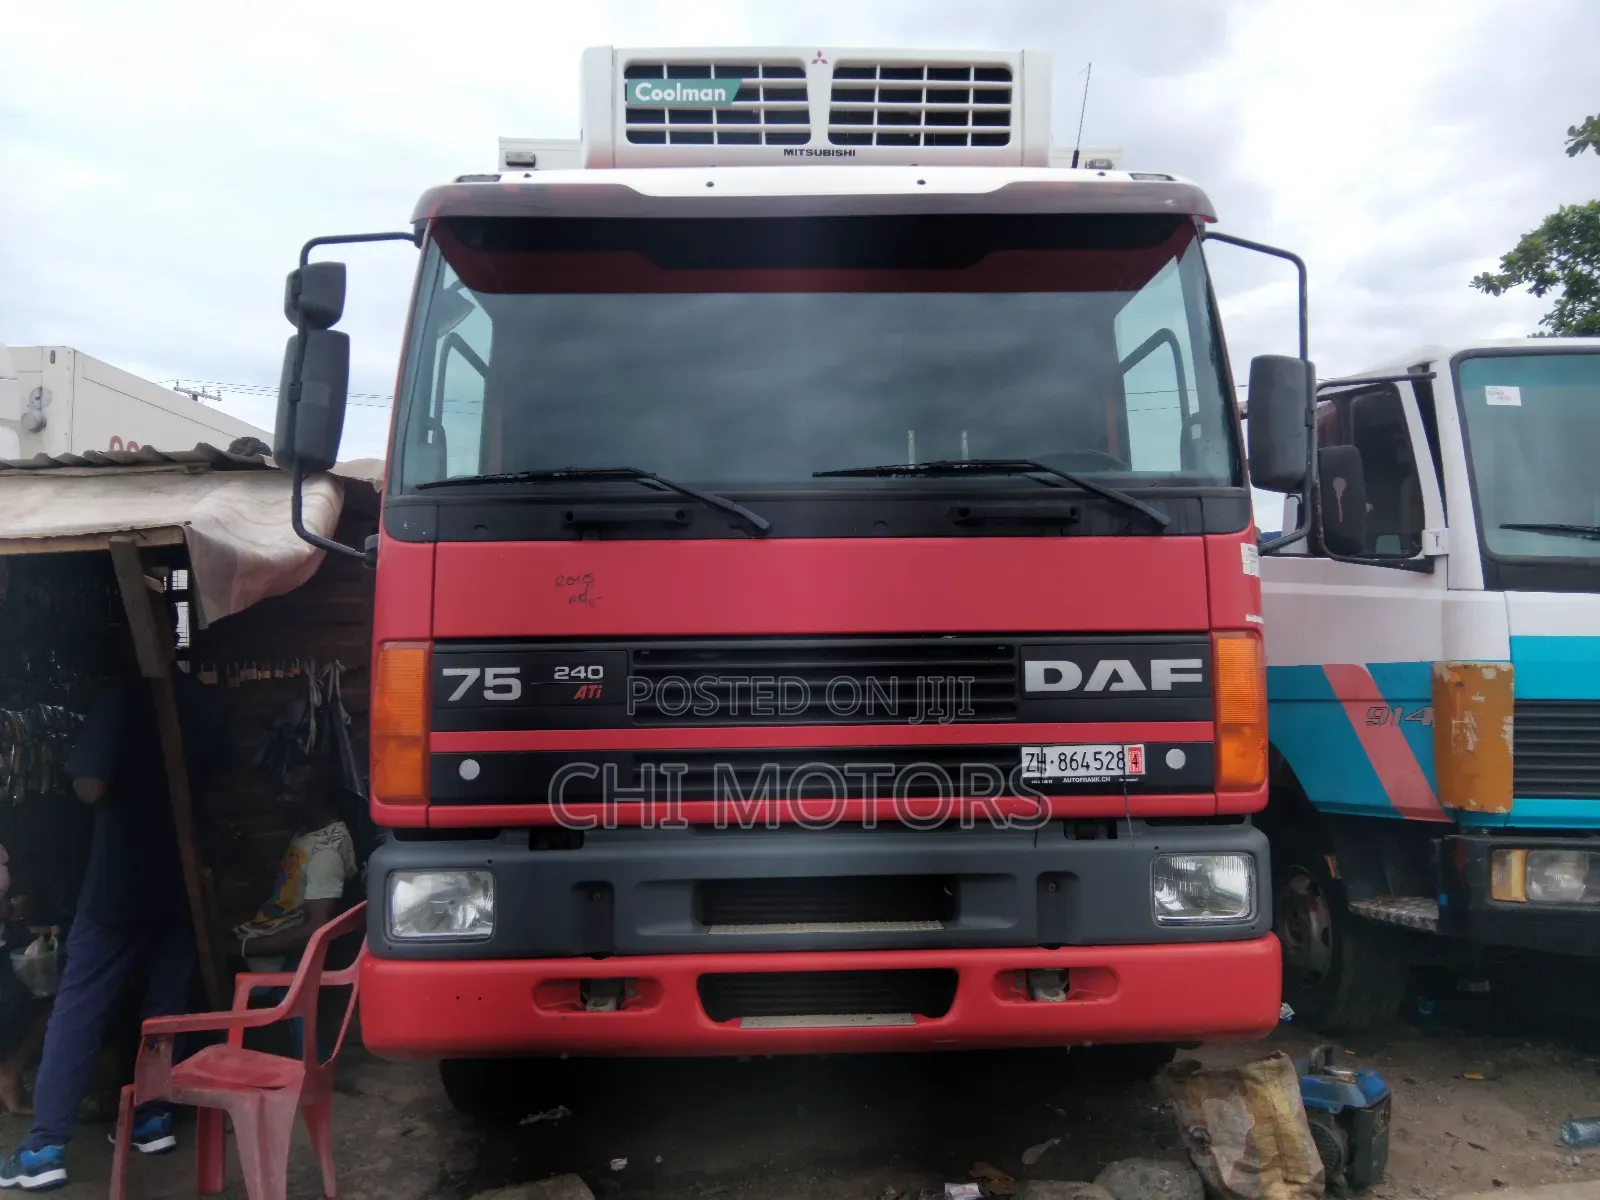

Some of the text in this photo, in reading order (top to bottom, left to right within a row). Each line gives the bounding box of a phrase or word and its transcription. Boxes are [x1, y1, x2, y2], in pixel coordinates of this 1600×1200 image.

[634, 82, 727, 103] Coolman
[783, 148, 856, 157] MITSUBISHI
[553, 665, 604, 680] 240
[1024, 659, 1203, 692] DAF
[442, 667, 522, 701] 75
[1365, 706, 1435, 727] 914
